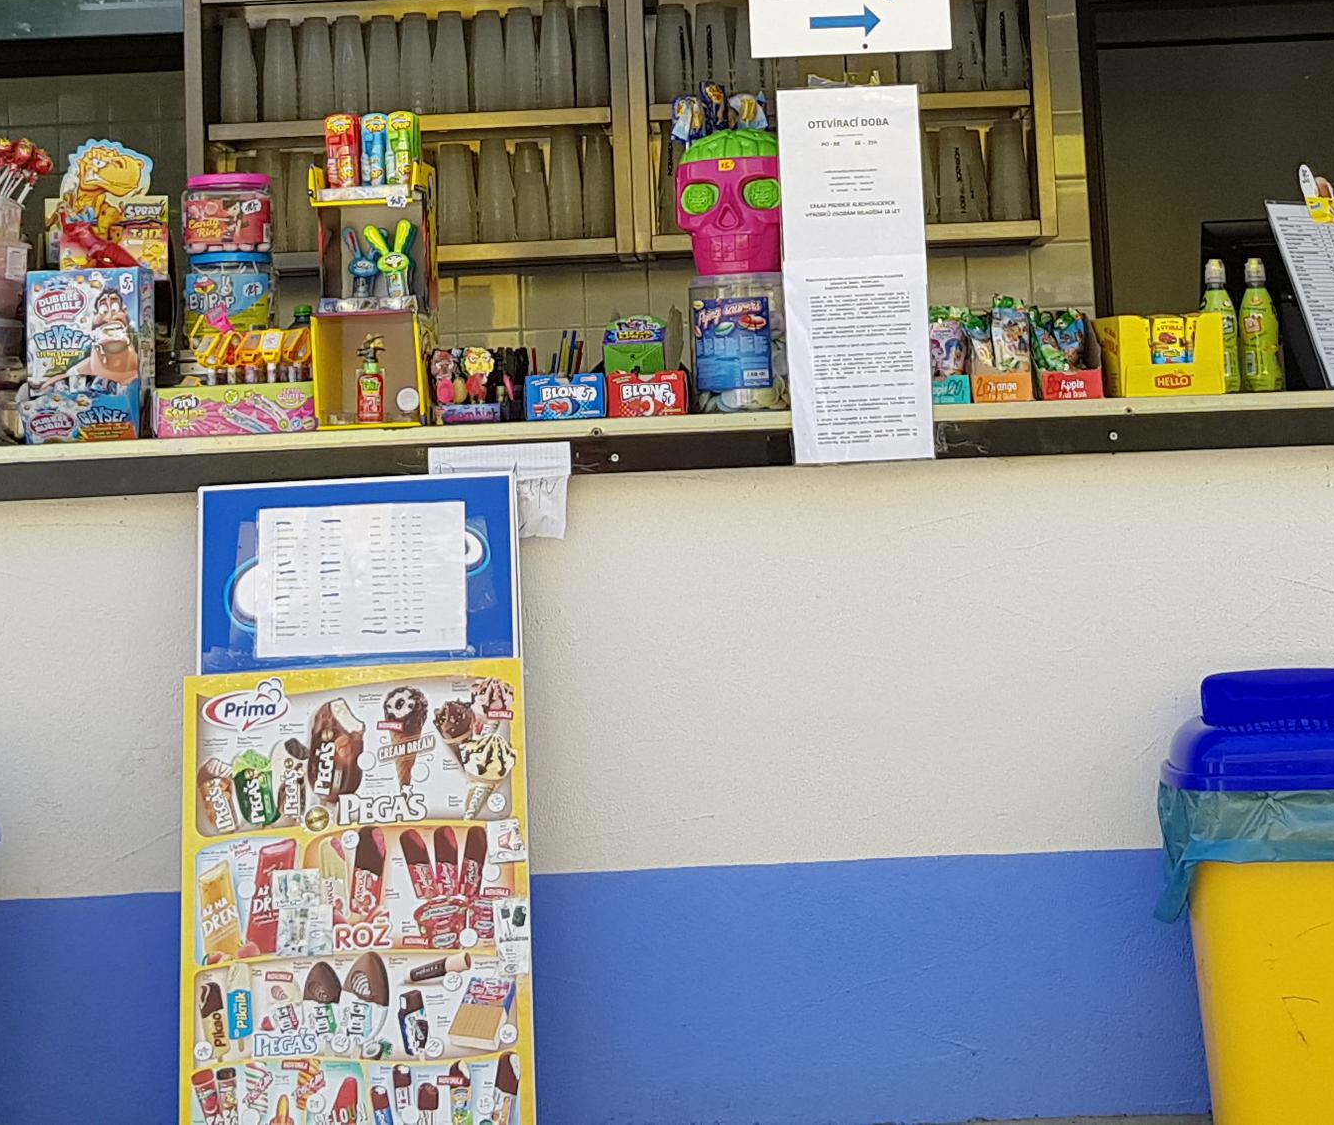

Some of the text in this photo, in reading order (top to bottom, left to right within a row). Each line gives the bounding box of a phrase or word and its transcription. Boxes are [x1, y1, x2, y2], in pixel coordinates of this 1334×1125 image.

[807, 116, 890, 130] OTEVÍRACÍ DOBA
[1060, 380, 1085, 390] Apple
[1157, 376, 1189, 387] HELLO
[224, 700, 277, 718] Prima
[378, 744, 406, 761] CREAM
[235, 991, 249, 1029] Piknik
[212, 1012, 227, 1048] Pikao
